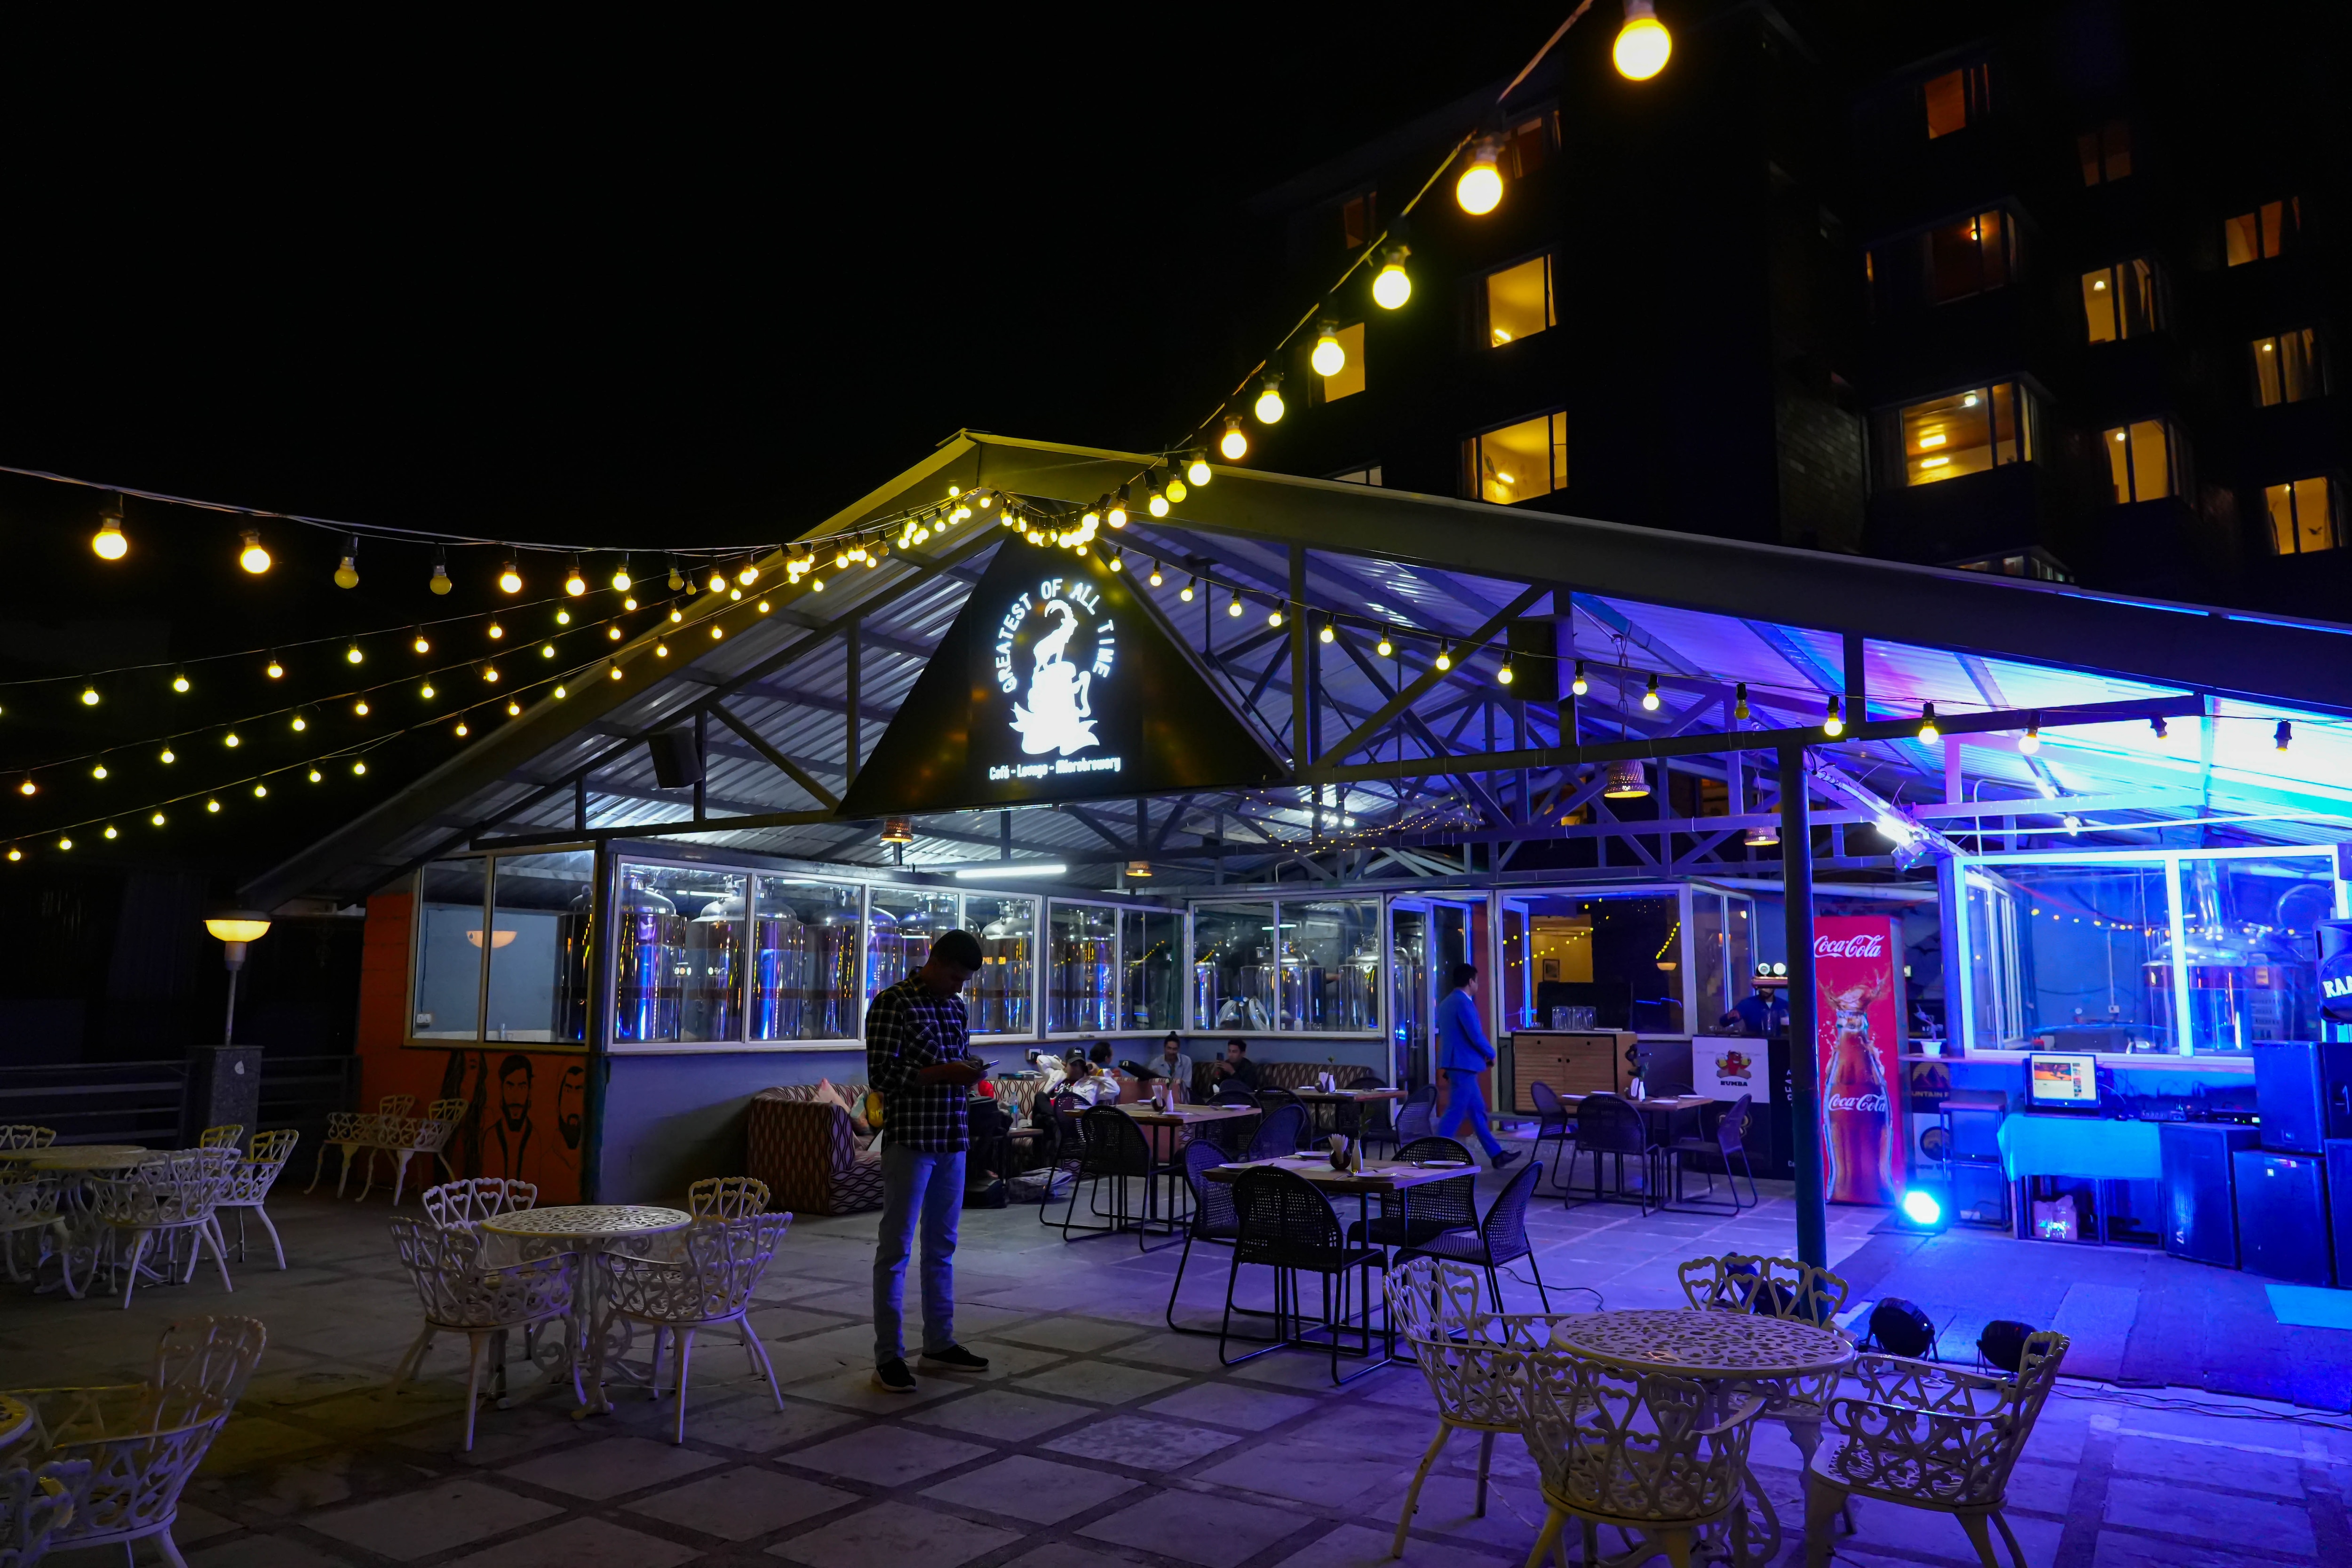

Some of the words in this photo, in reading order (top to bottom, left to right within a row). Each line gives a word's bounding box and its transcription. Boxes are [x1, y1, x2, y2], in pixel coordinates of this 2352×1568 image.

[996, 592, 1032, 693] GREATEST
[1041, 579, 1063, 599] OF
[1069, 582, 1100, 615] ALL
[1093, 620, 1115, 677] TIME
[1814, 935, 1884, 958] Coca-Cola
[1828, 1093, 1886, 1112] Coca-Cola
